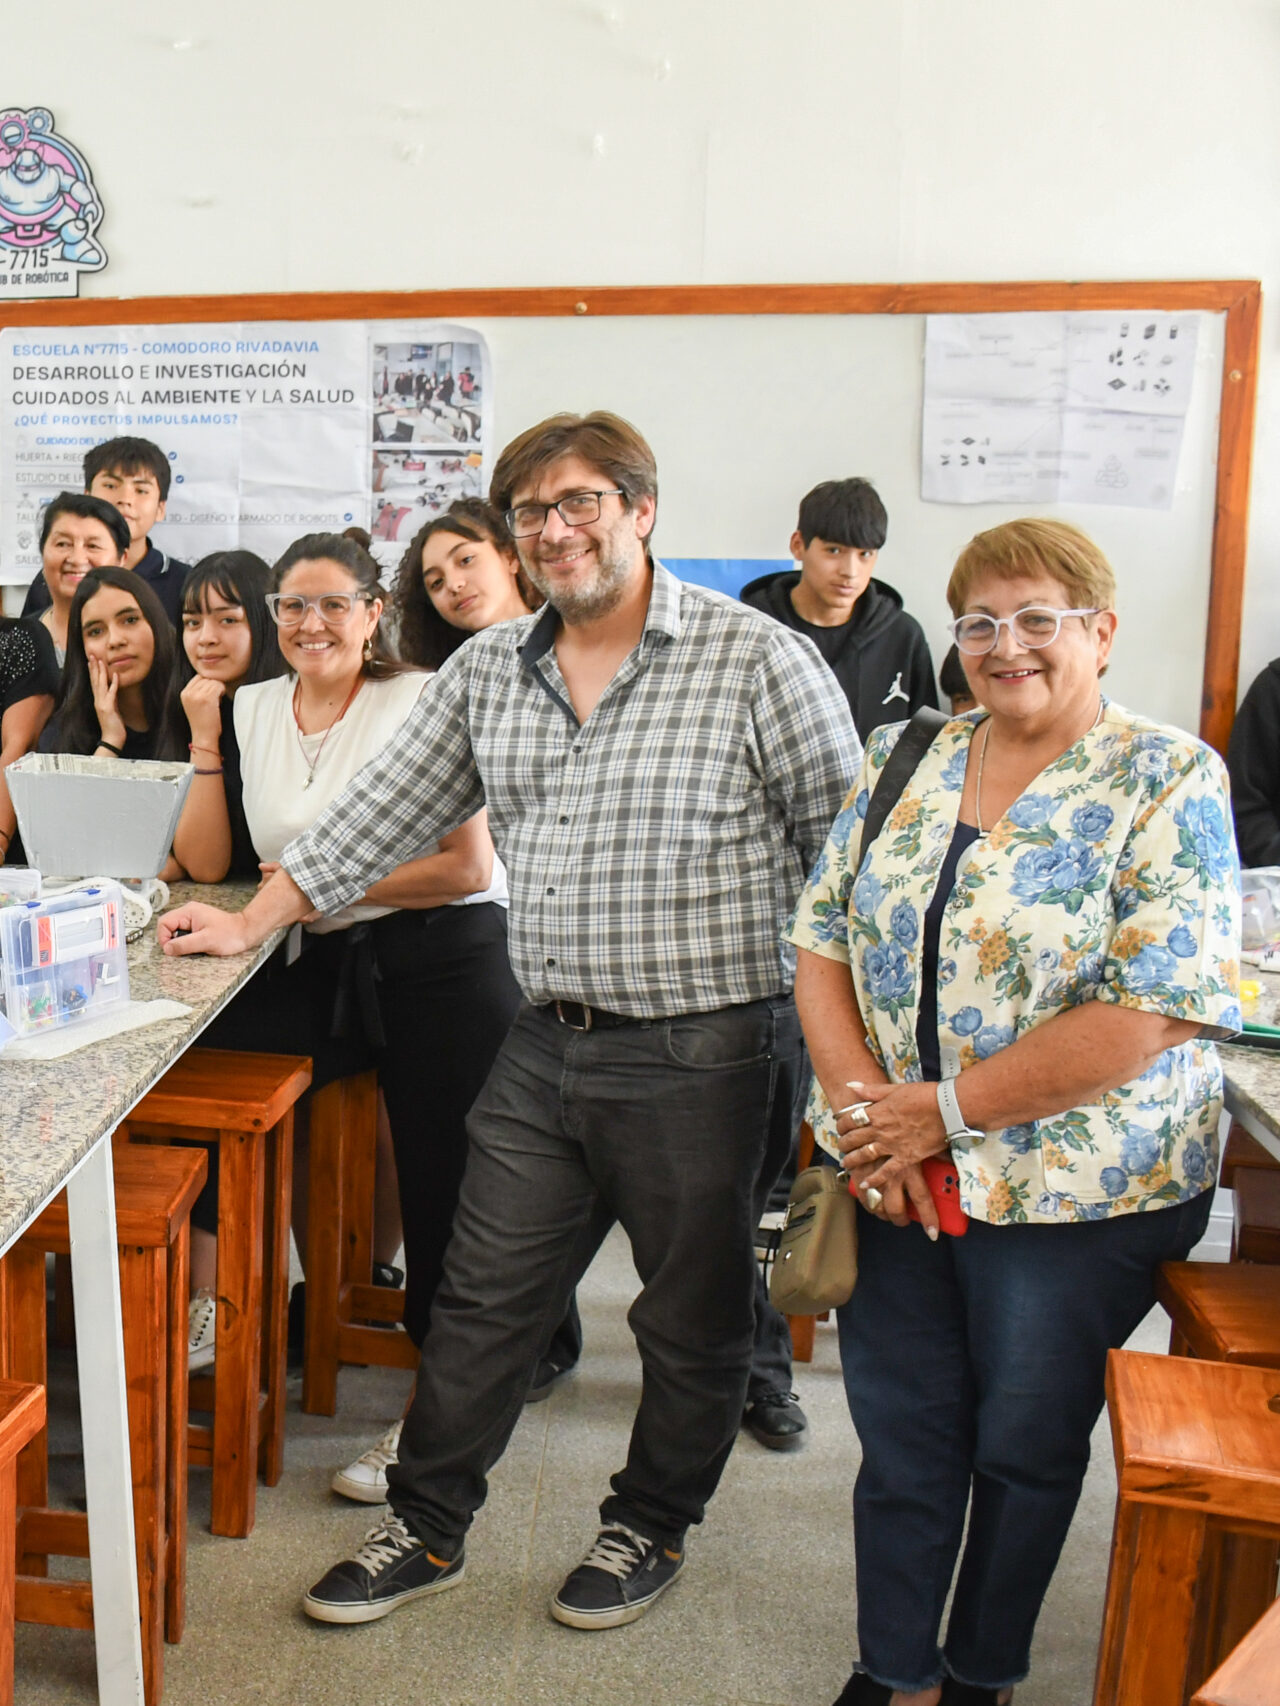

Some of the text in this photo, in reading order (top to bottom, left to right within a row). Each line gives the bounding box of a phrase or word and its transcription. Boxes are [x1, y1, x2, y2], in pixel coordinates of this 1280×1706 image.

[10, 248, 49, 270] 7715
[11, 273, 23, 285] DE
[25, 270, 69, 283] ROBÓTICA
[13, 344, 80, 357] ESCUELA
[141, 342, 232, 355] COMODORO
[236, 341, 320, 353] RIVADAVIA
[13, 359, 306, 381] DESARROLLO E INVESTIGACIÓN
[12, 389, 355, 405] CUIDADOS AL AMBIENTE Y LA SALUD
[14, 412, 238, 427] ¿QUÉ PROYECTOS IMPULSAMOS?
[15, 453, 52, 462] HUERTA
